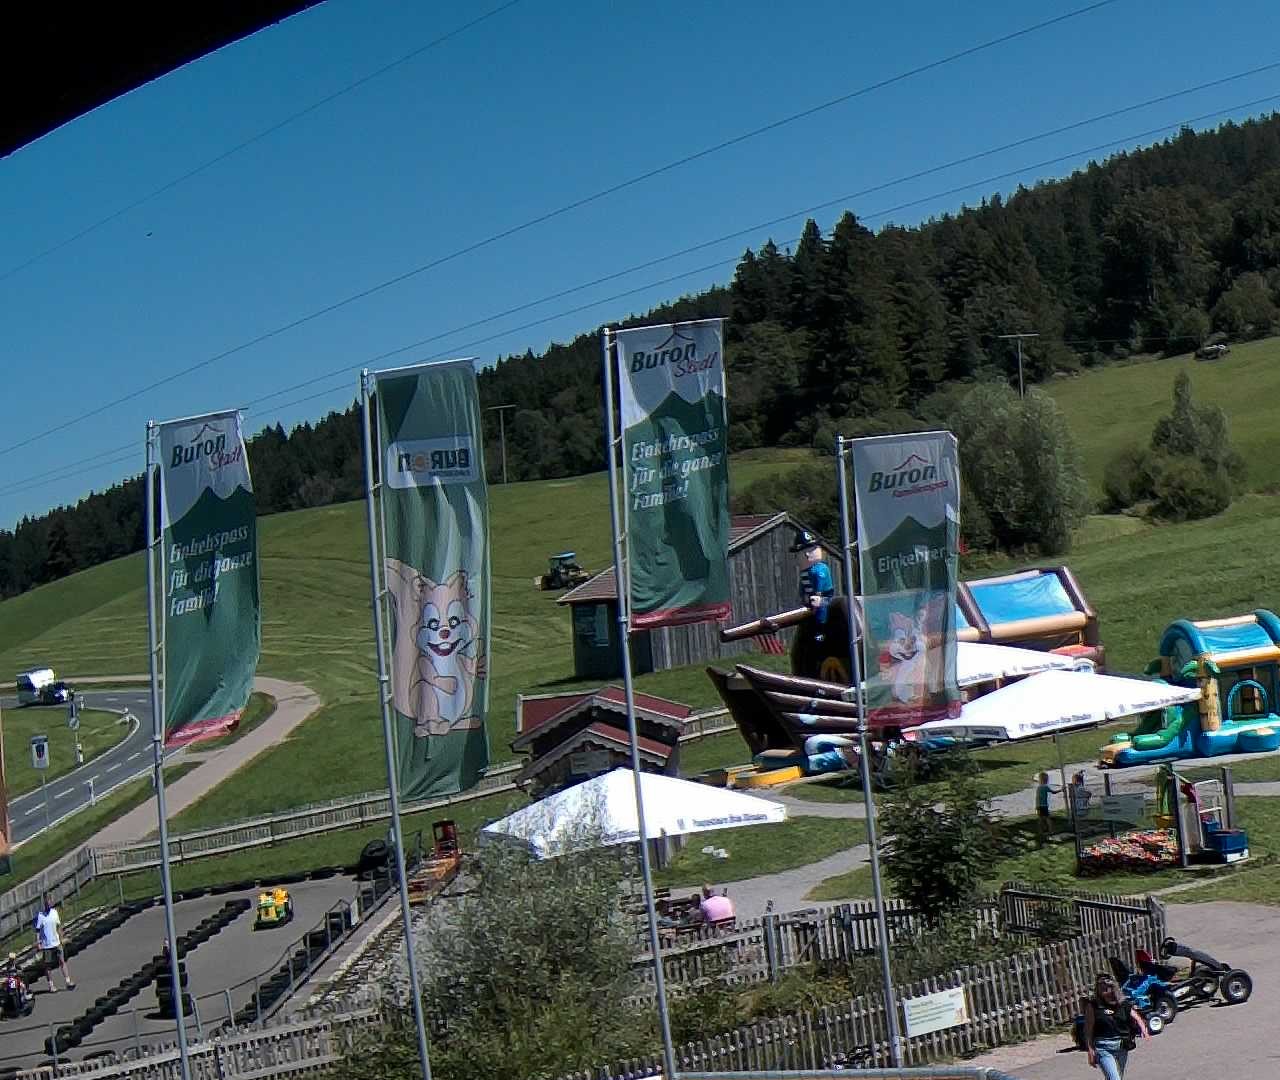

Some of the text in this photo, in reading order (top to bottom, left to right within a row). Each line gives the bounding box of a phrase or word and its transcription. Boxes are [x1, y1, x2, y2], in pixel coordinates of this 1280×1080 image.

[631, 343, 697, 373] Buron
[170, 433, 226, 468] Buron
[868, 465, 936, 493] Buron
